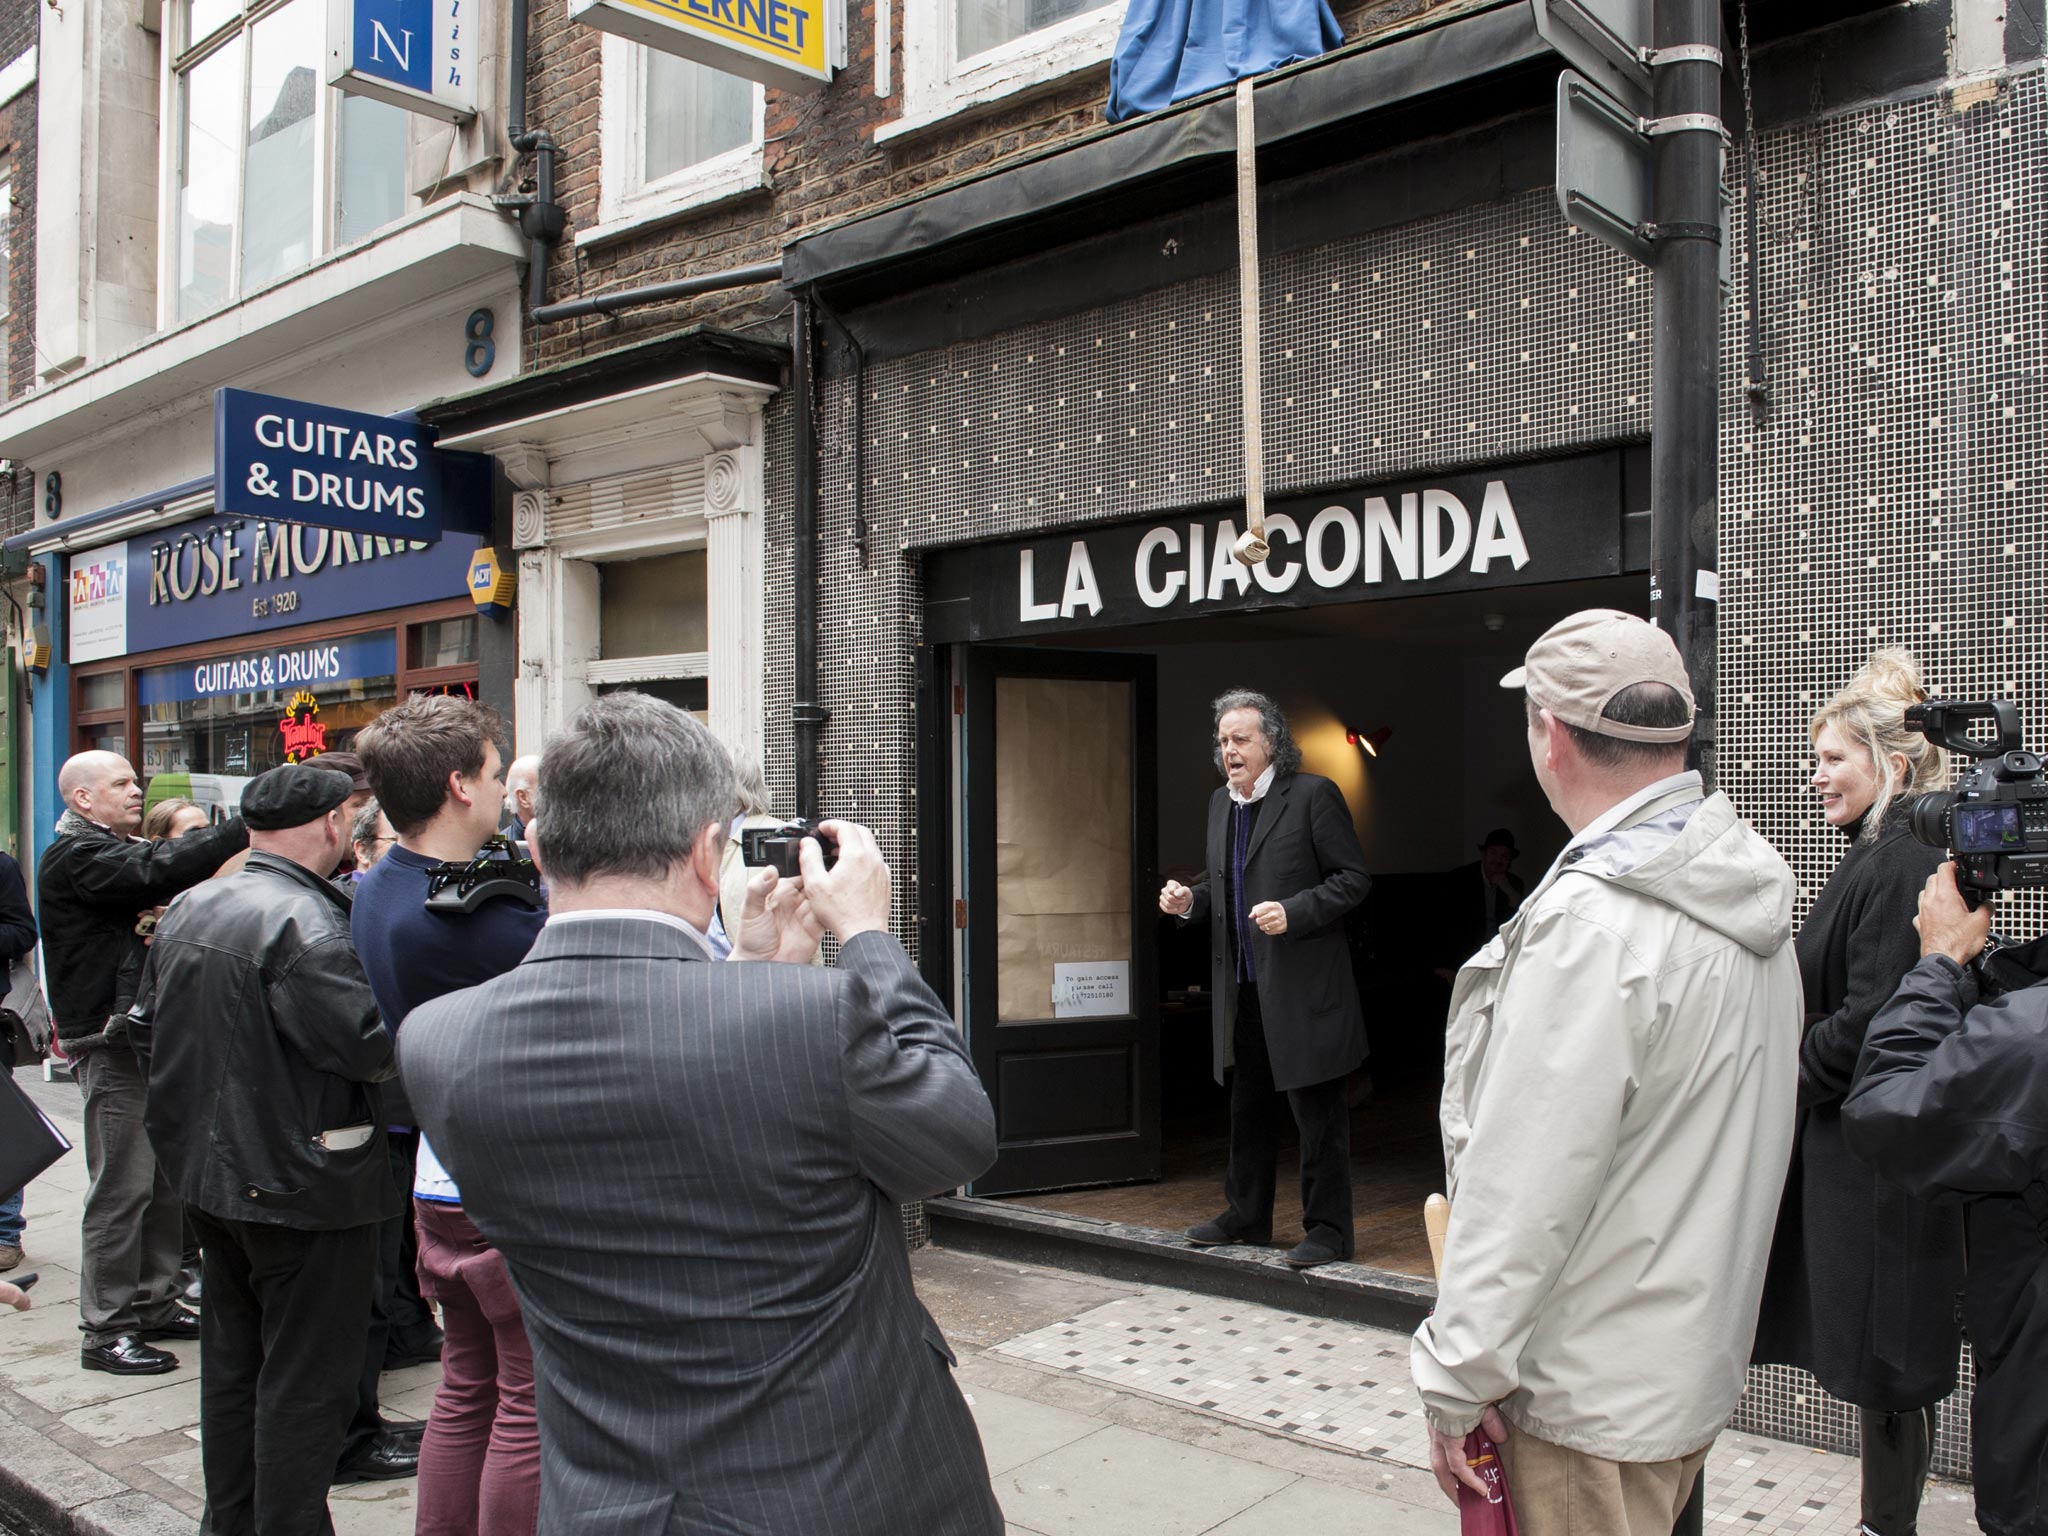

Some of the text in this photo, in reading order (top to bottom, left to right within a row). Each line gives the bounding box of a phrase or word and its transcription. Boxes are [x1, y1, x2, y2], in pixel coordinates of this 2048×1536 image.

[369, 19, 414, 71] N
[672, 0, 808, 48] RNET
[465, 307, 495, 377] 8
[255, 414, 418, 471] GUITARS
[46, 471, 62, 519] 8
[246, 462, 426, 519] & DRUMS
[150, 520, 429, 605] ROSE MOR
[474, 567, 491, 585] ADT
[1020, 540, 1103, 622] LA
[253, 591, 297, 617] Est 1920
[195, 646, 339, 693] GUITARS & DRUMS
[285, 690, 320, 717] QUALITY
